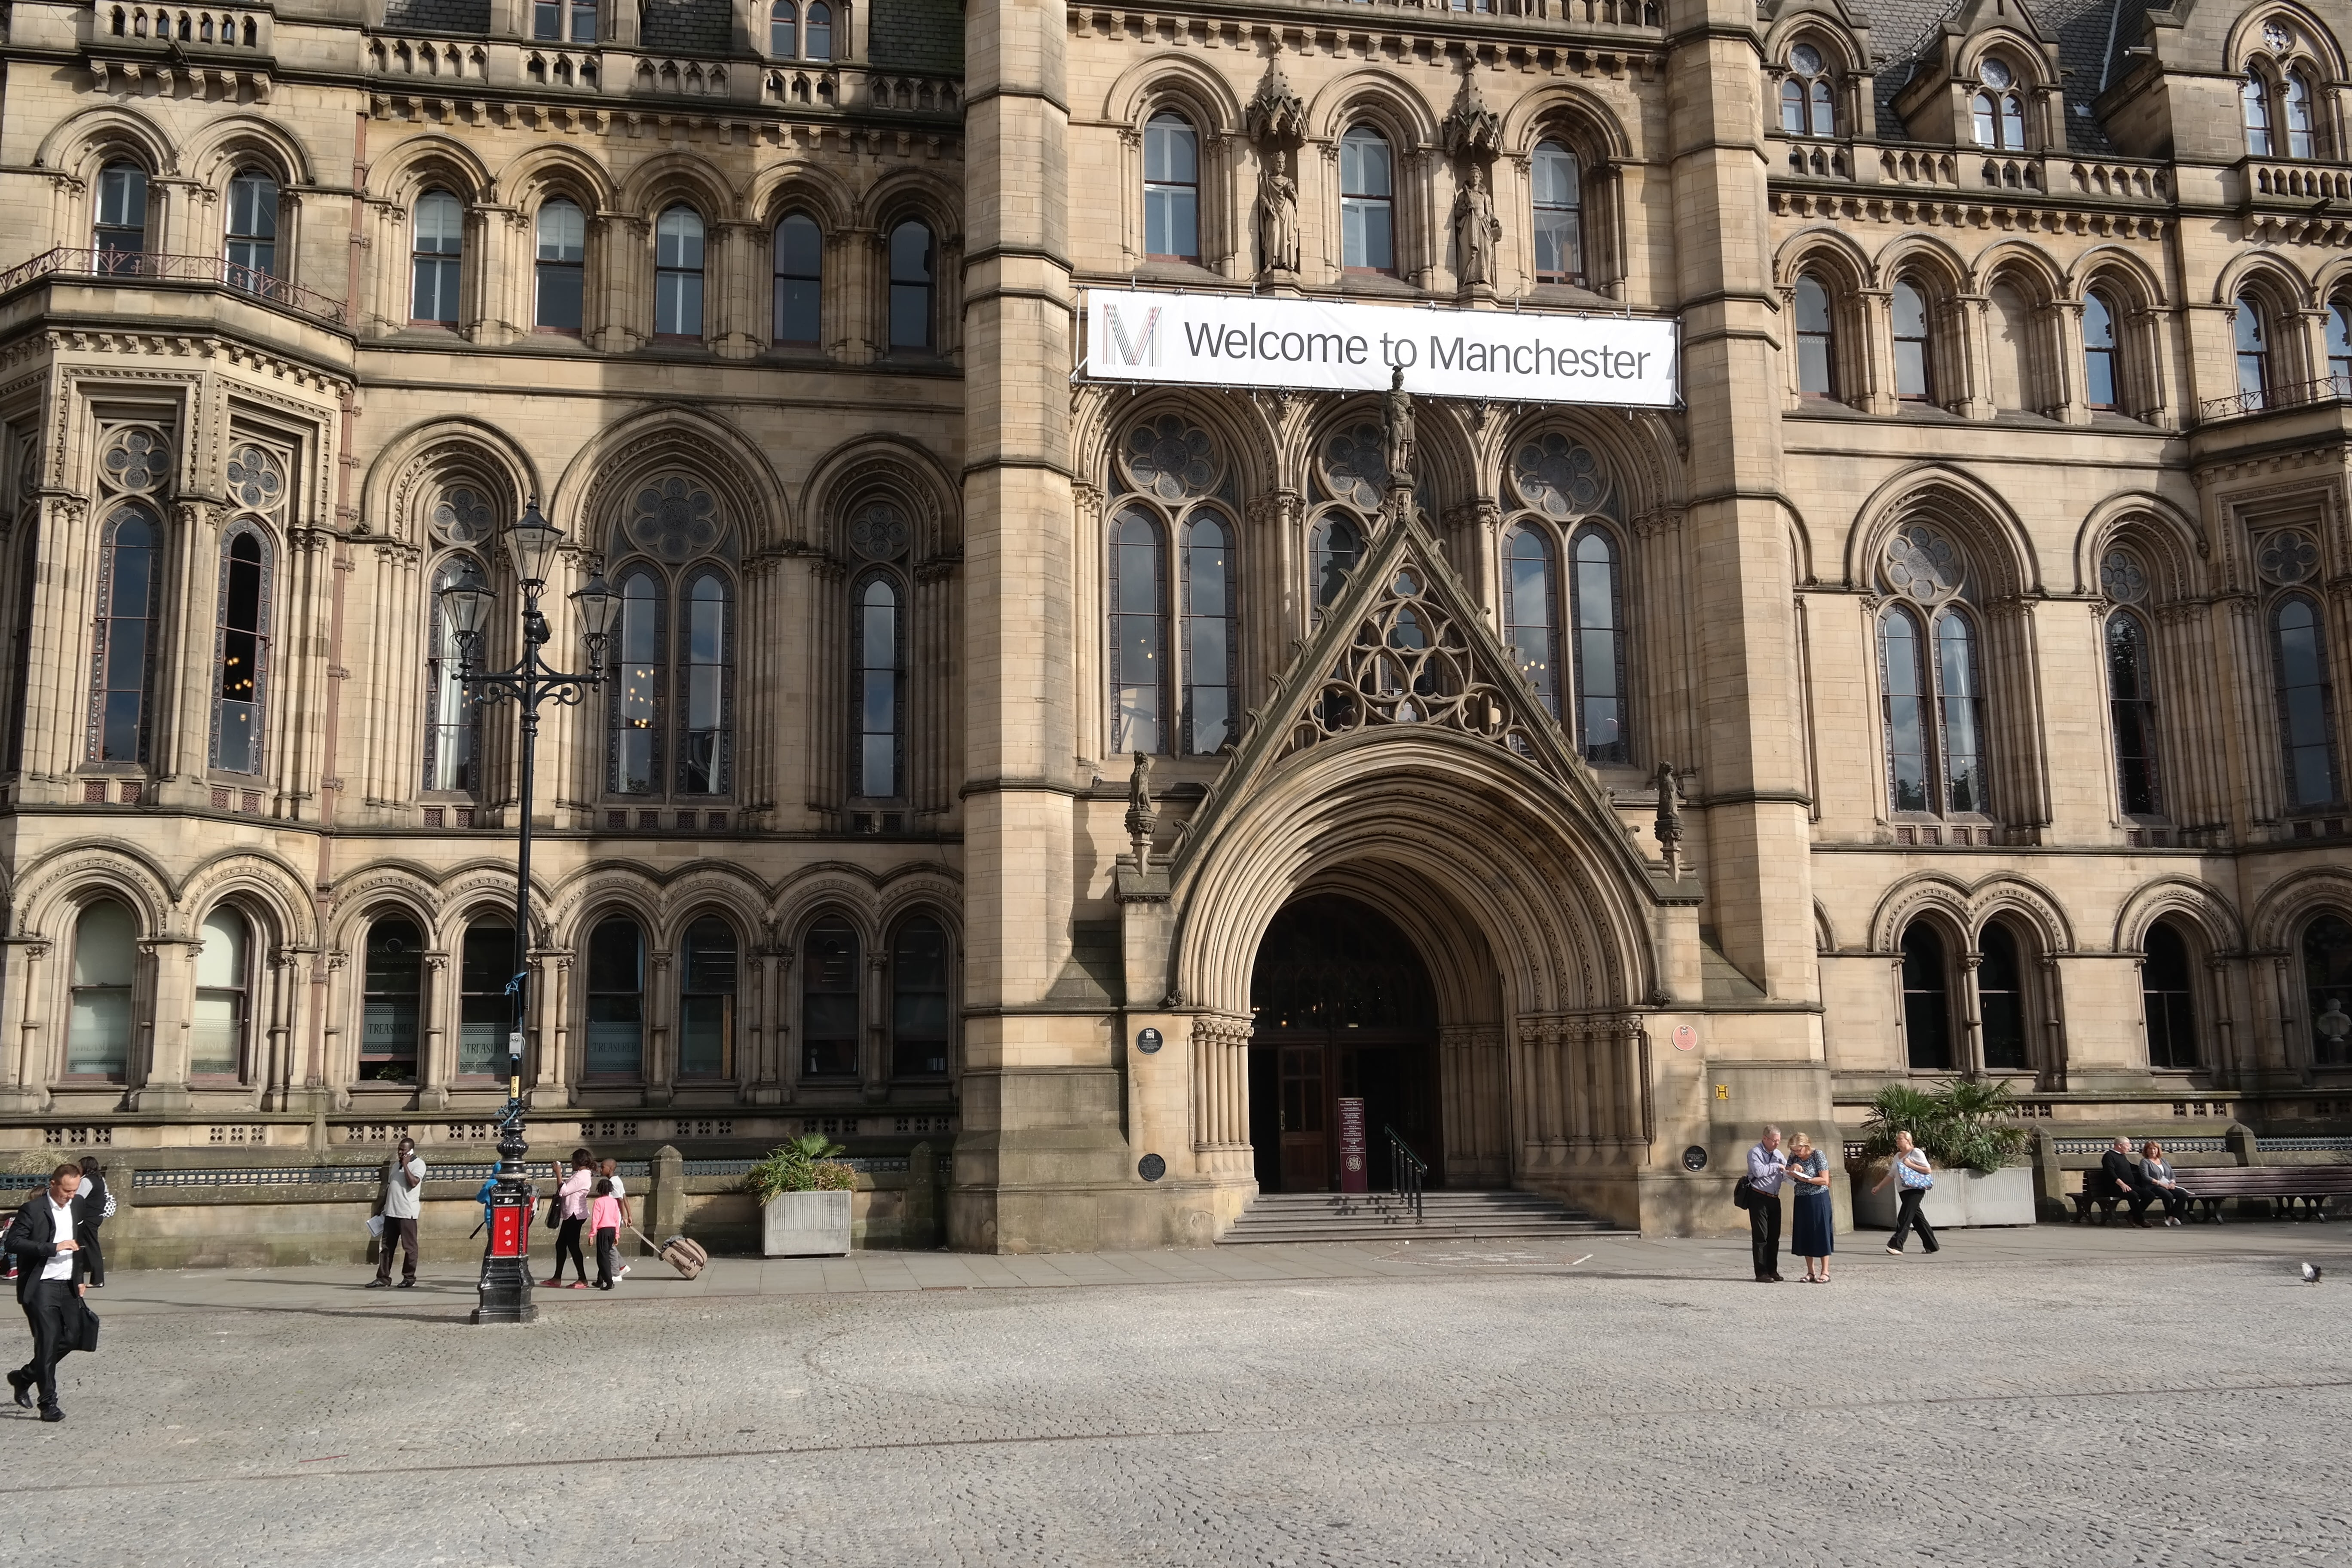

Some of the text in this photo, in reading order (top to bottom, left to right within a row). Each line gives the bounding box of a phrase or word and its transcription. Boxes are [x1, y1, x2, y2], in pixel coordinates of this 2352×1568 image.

[1185, 322, 1651, 379] Welcome to Manchester
[367, 1023, 414, 1034] TREASURER
[592, 1042, 637, 1053] TREASURER
